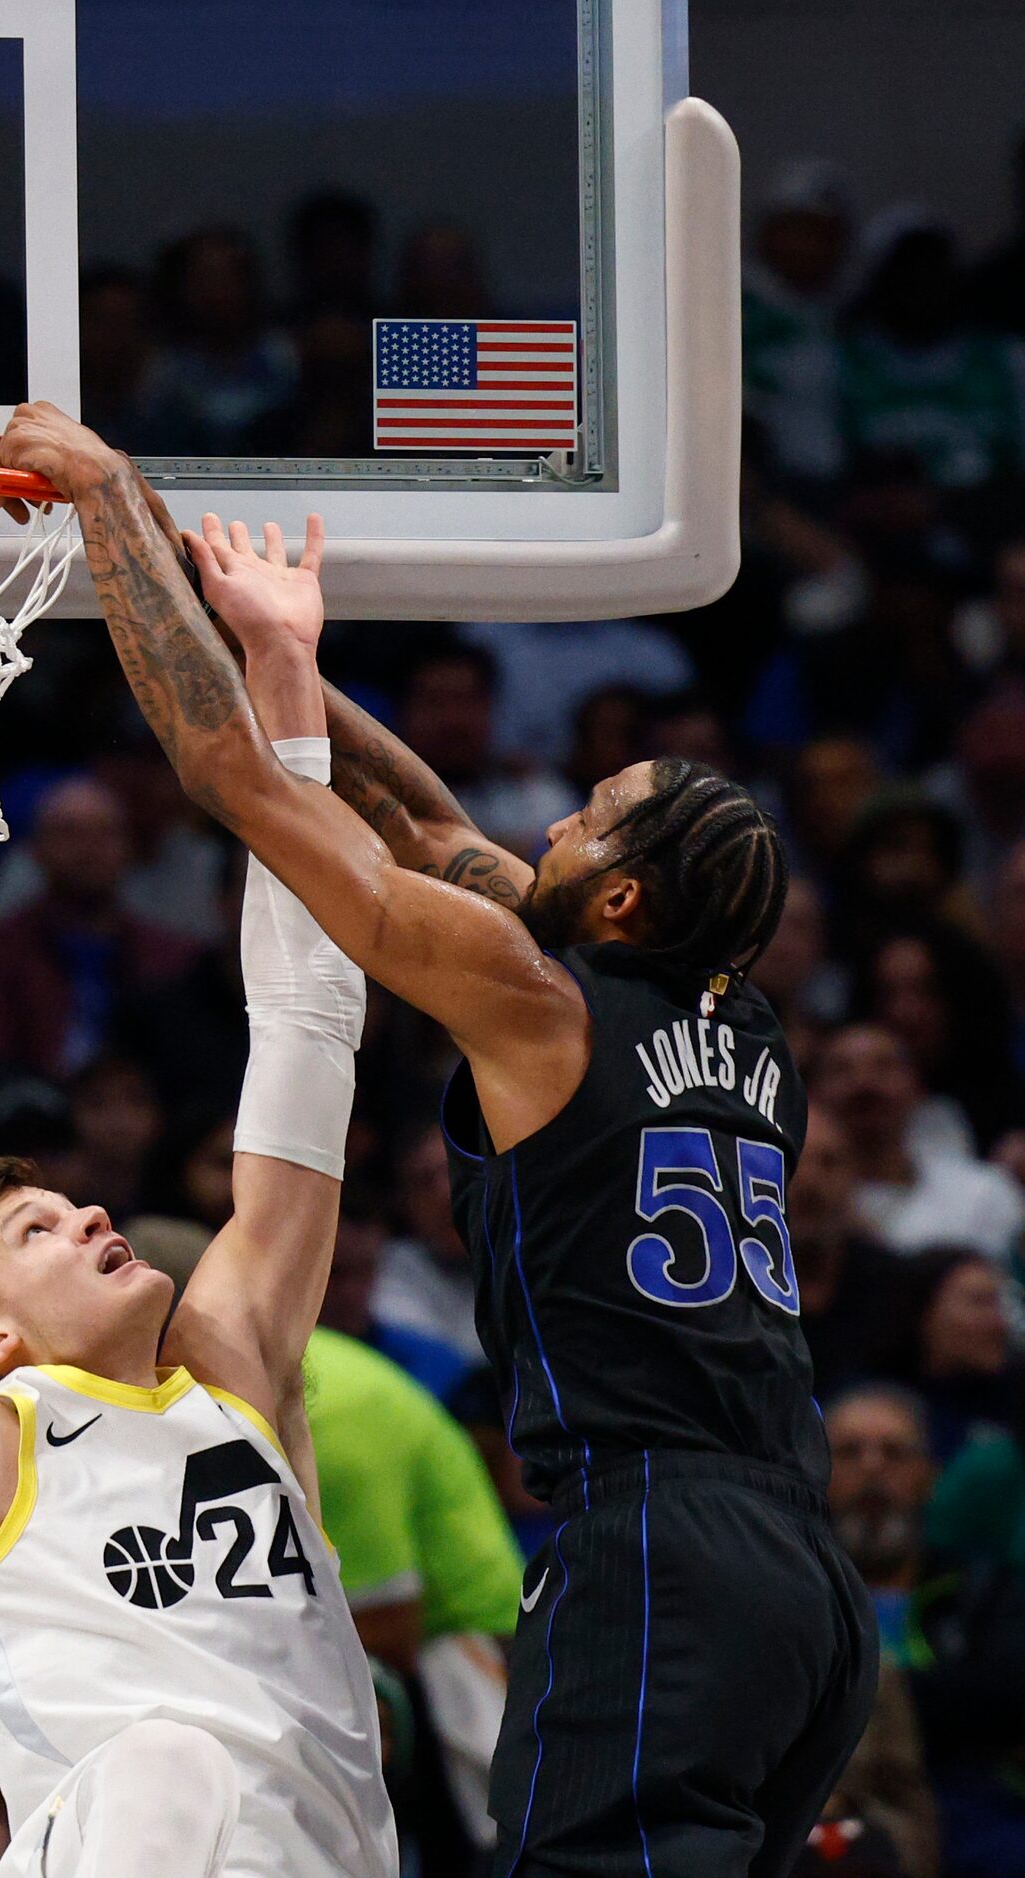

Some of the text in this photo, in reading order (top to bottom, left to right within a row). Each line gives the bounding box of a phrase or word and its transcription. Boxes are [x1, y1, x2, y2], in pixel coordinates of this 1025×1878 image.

[635, 1017, 783, 1134] JONES JR.
[626, 1126, 801, 1316] 55
[195, 1494, 317, 1599] 24
